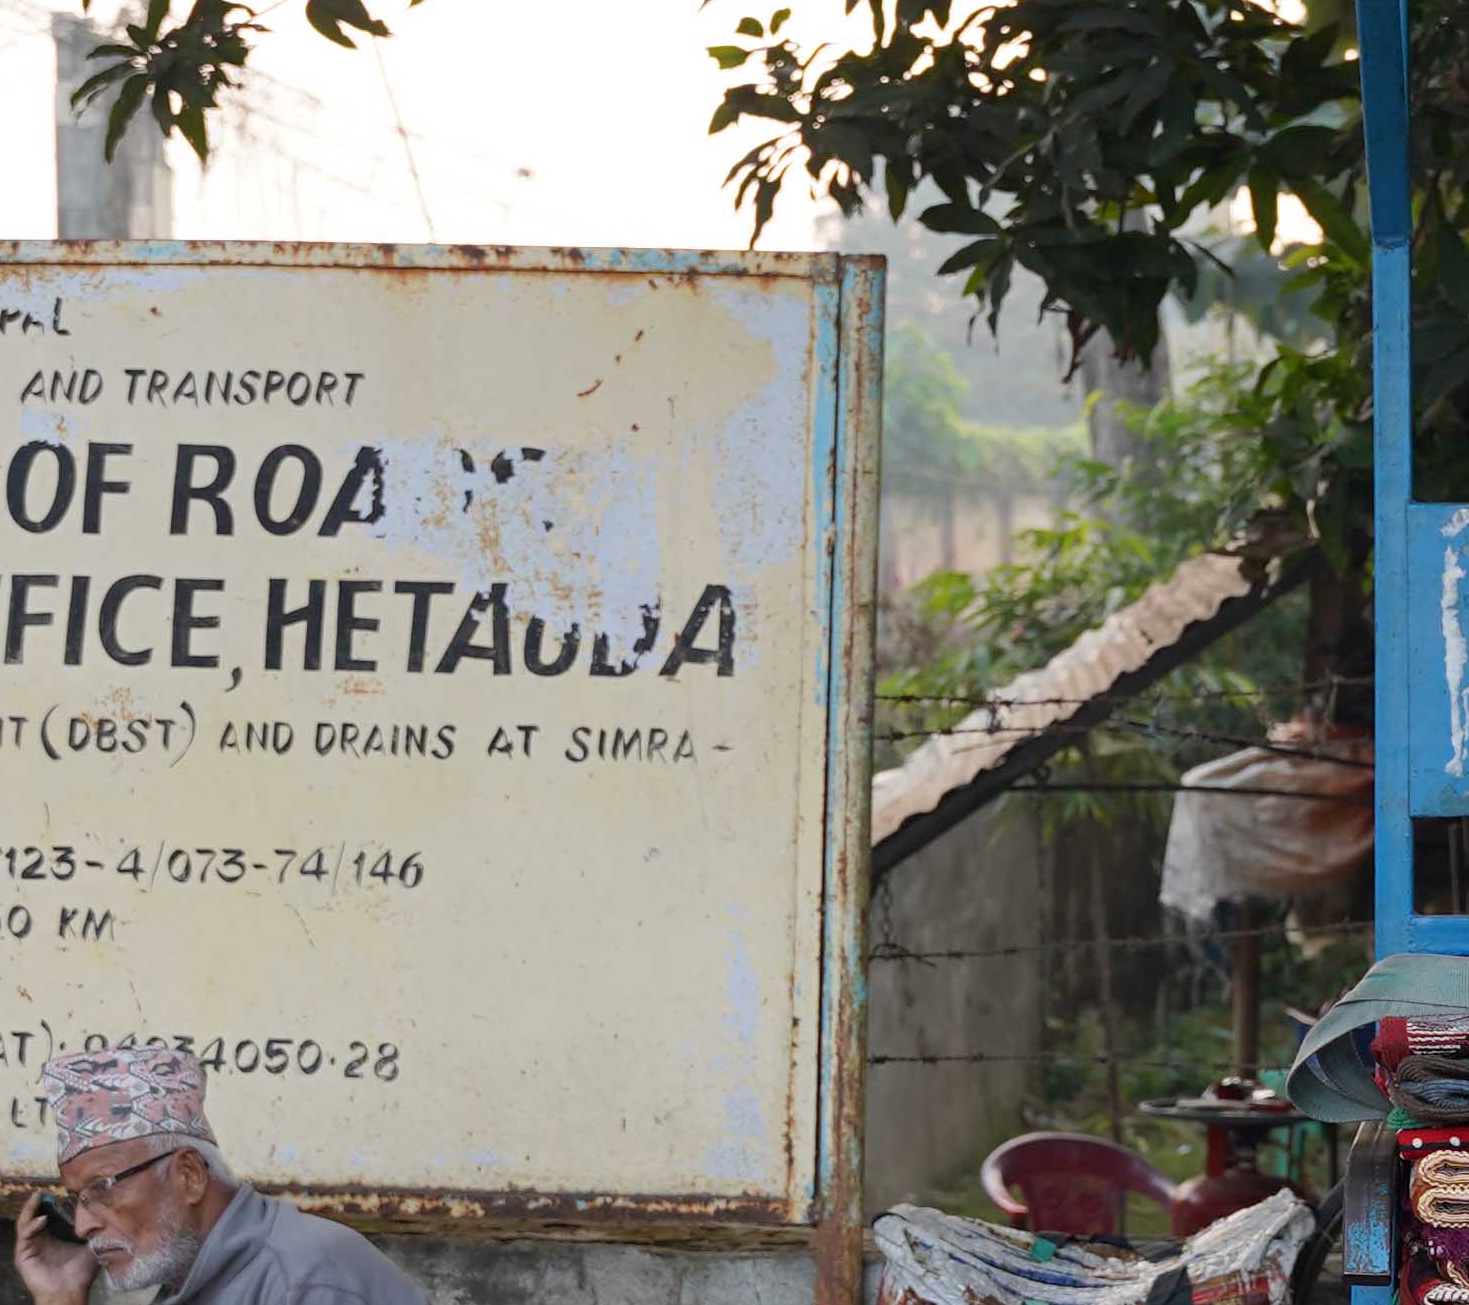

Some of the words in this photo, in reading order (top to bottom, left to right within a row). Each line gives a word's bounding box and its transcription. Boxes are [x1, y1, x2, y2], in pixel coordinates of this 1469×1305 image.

[21, 370, 103, 407] AND
[125, 368, 364, 407] TRANSPORT
[6, 440, 134, 537] OF
[39, 700, 194, 767] (DBST)
[218, 720, 295, 755] AND
[314, 721, 458, 760] DRAINS
[487, 724, 540, 758] AT
[59, 906, 115, 941] KM
